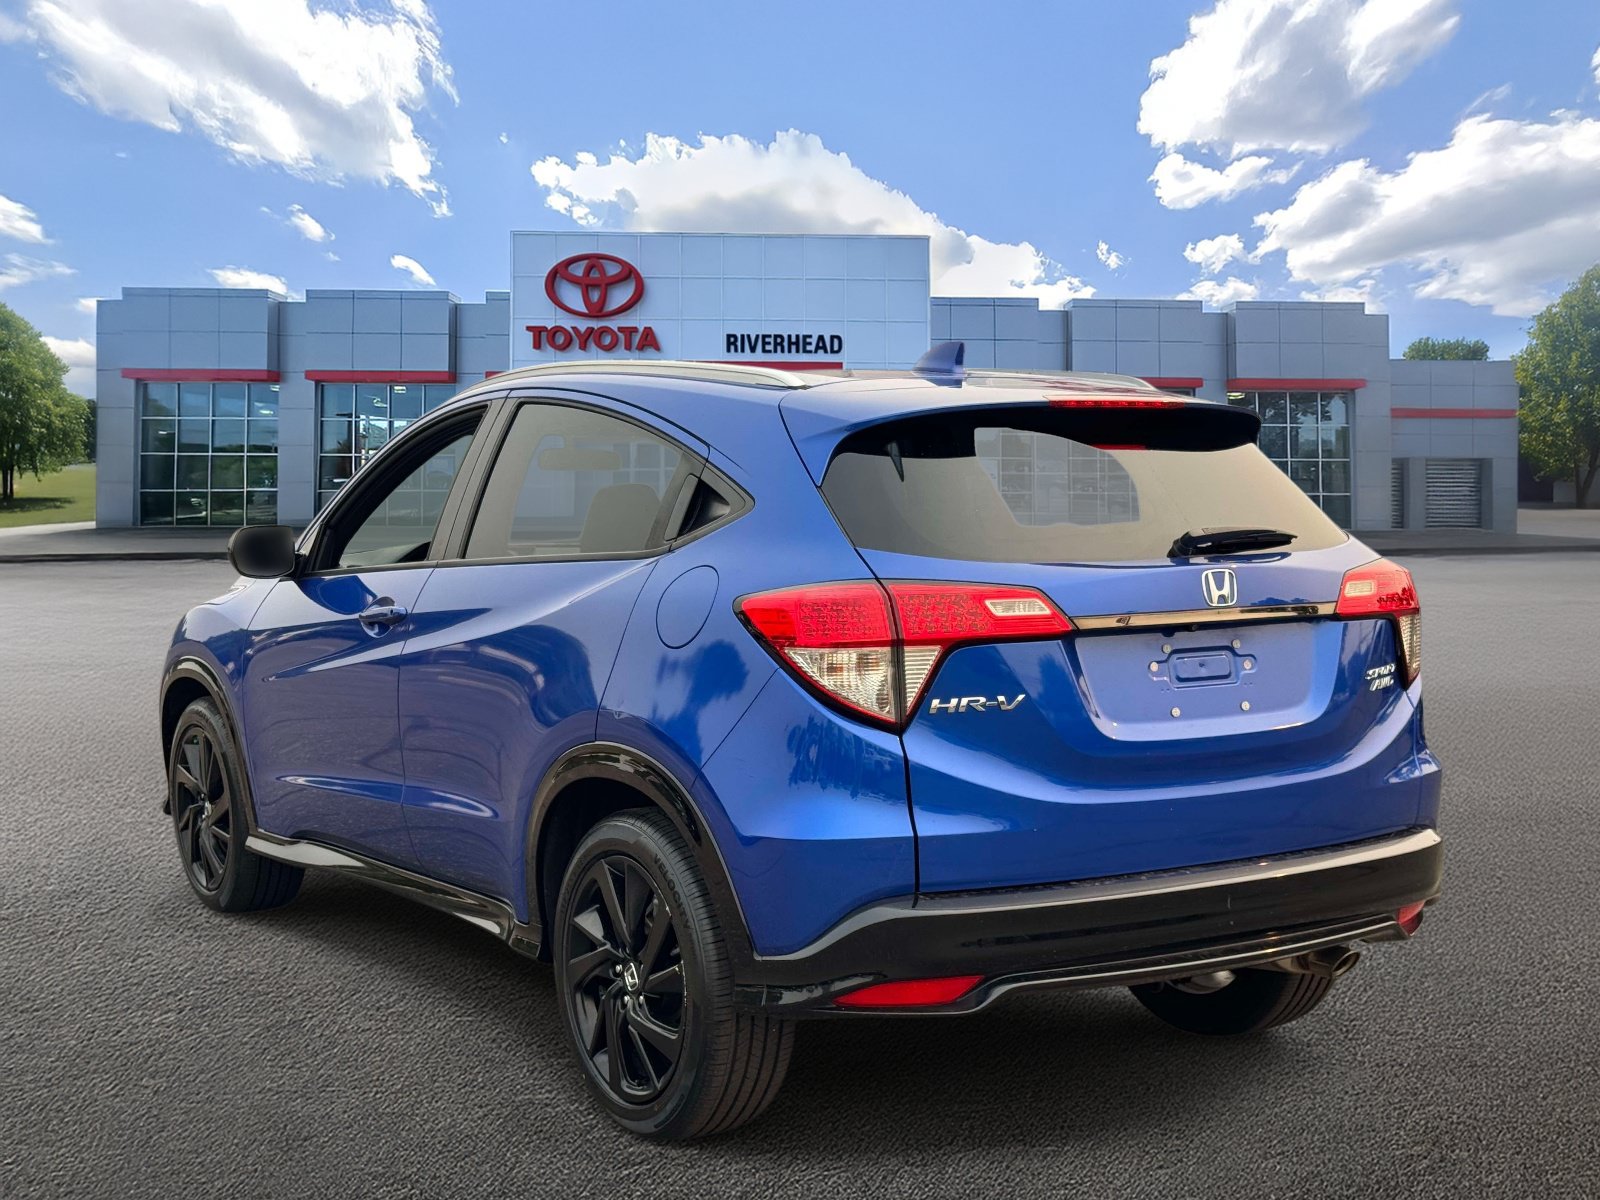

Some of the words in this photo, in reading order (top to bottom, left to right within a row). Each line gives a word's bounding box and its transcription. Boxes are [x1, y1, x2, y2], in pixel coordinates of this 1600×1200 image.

[525, 325, 661, 351] TOYOTA
[726, 334, 843, 354] RIVERHEAD
[929, 694, 1026, 714] HR-V
